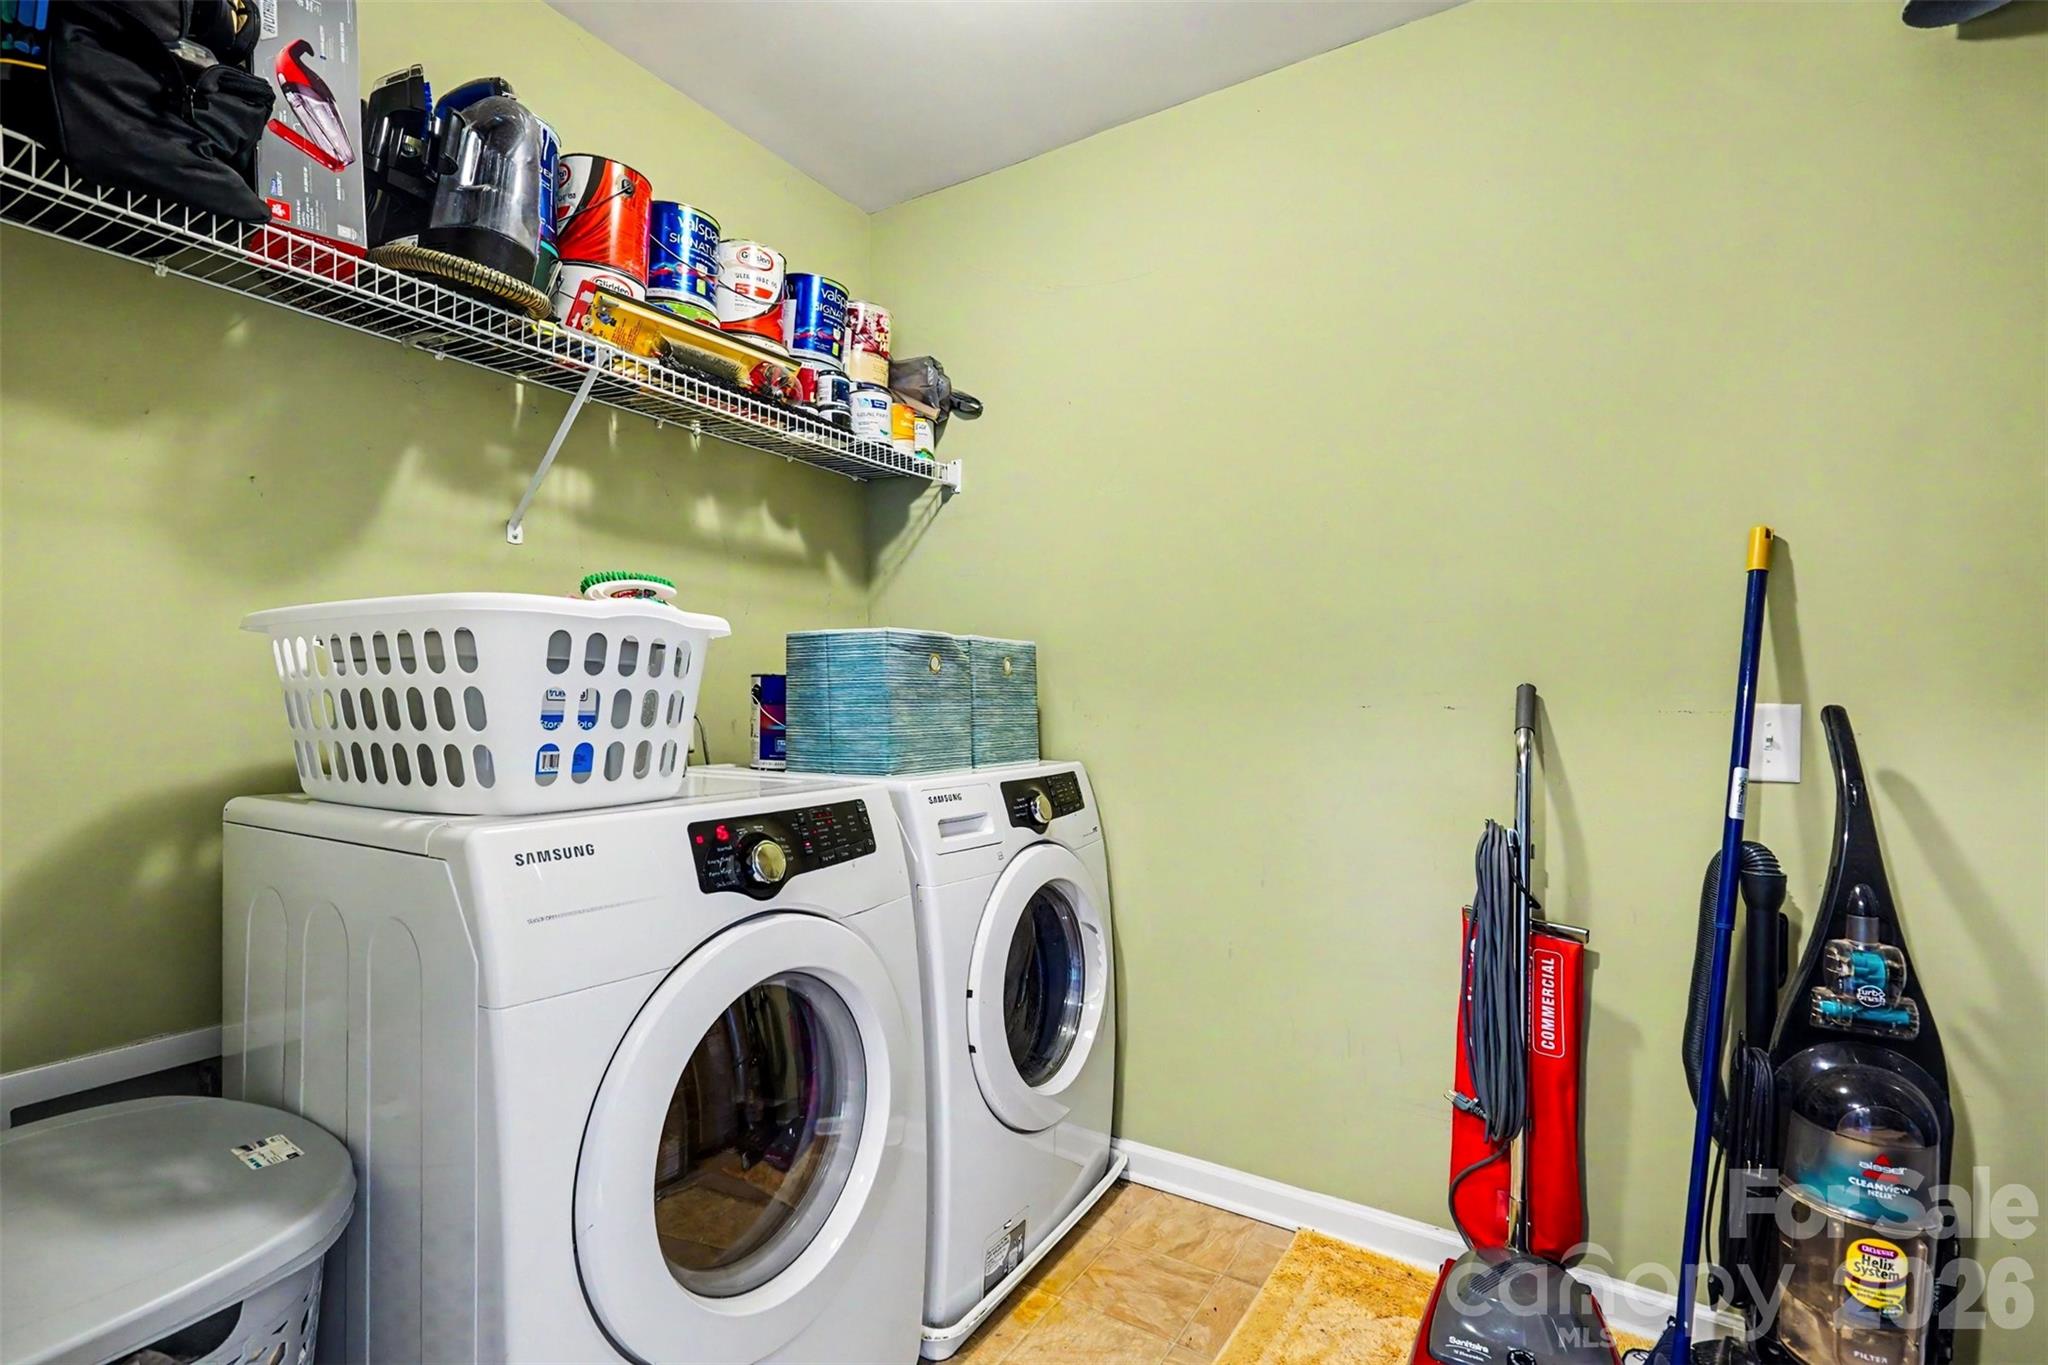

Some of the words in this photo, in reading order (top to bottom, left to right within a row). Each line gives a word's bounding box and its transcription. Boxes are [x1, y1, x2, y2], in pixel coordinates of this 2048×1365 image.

[677, 215, 719, 244] valspa
[928, 793, 962, 804] SAMSUNG
[514, 843, 595, 867] SAMSUNG
[1541, 957, 1555, 1051] COMMERCIAL
[1854, 1261, 1900, 1281] System
[1861, 1254, 1895, 1272] Helix
